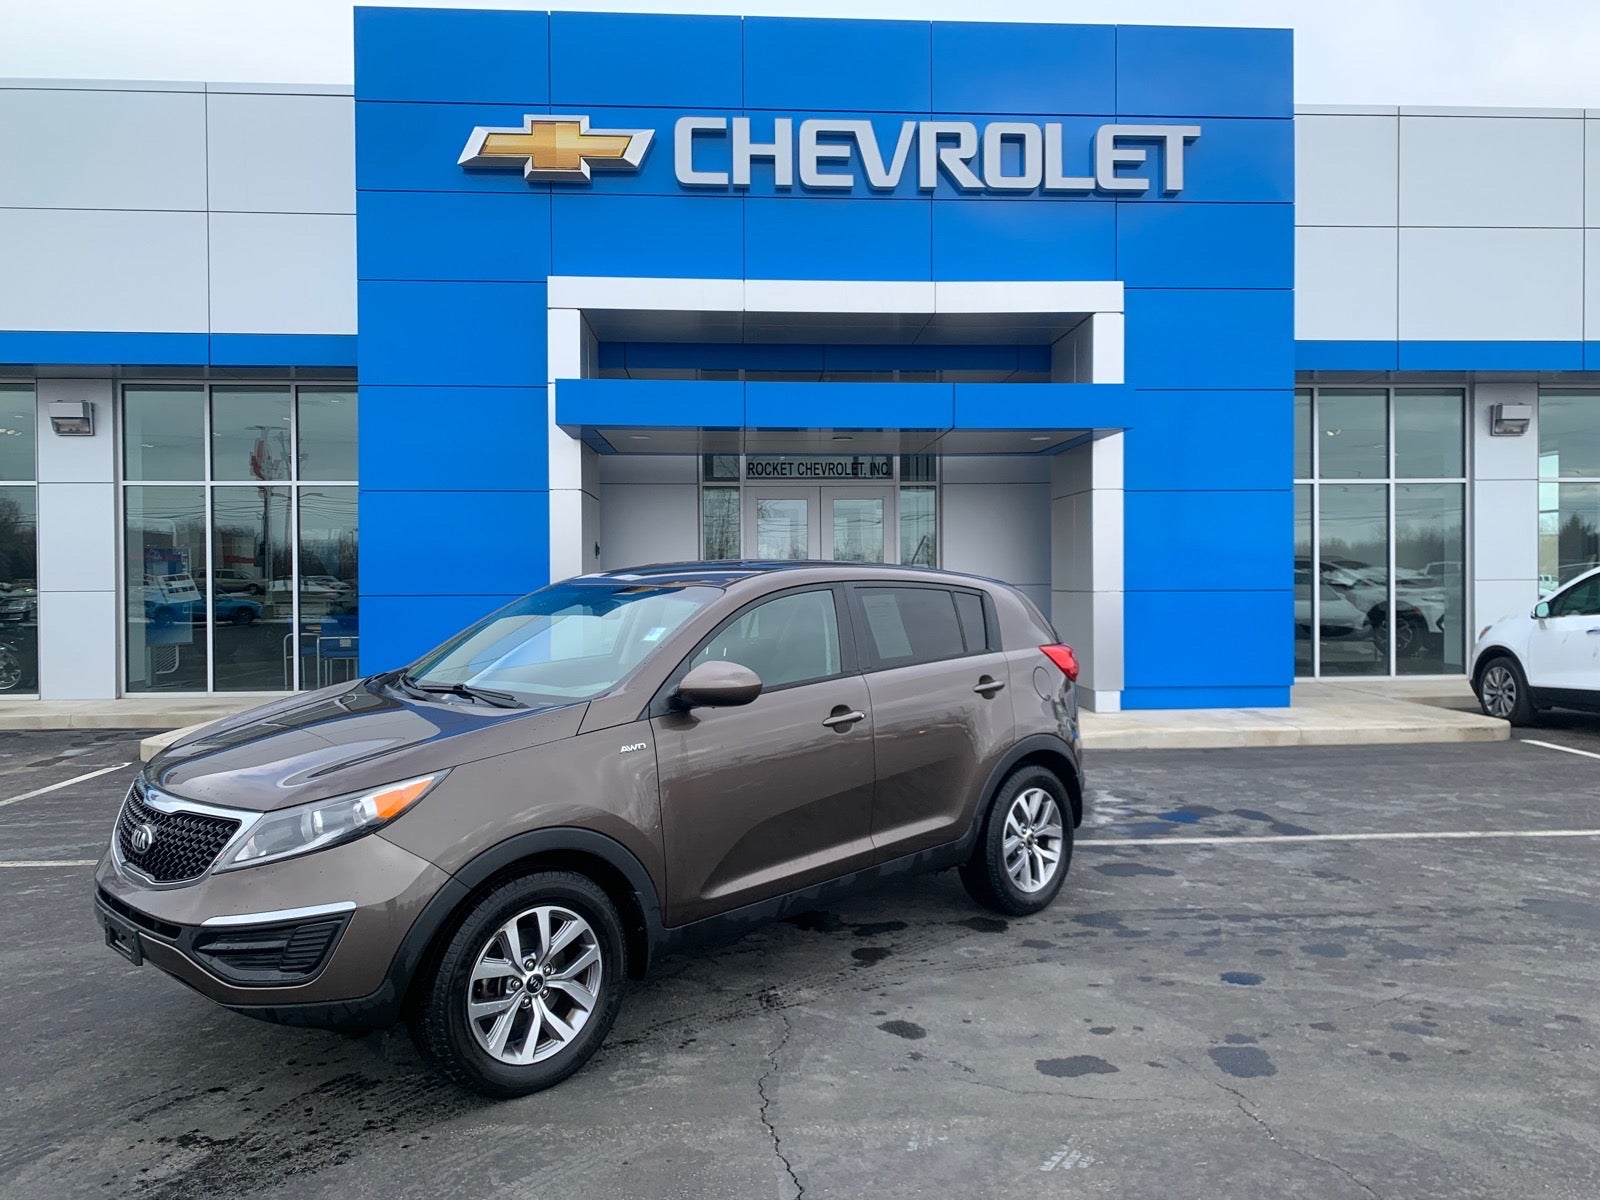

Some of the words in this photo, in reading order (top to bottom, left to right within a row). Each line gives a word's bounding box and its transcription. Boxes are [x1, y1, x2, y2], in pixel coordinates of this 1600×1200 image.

[674, 115, 1202, 193] CHEVROLET
[747, 462, 794, 476] ROCKET
[620, 742, 647, 753] AWD
